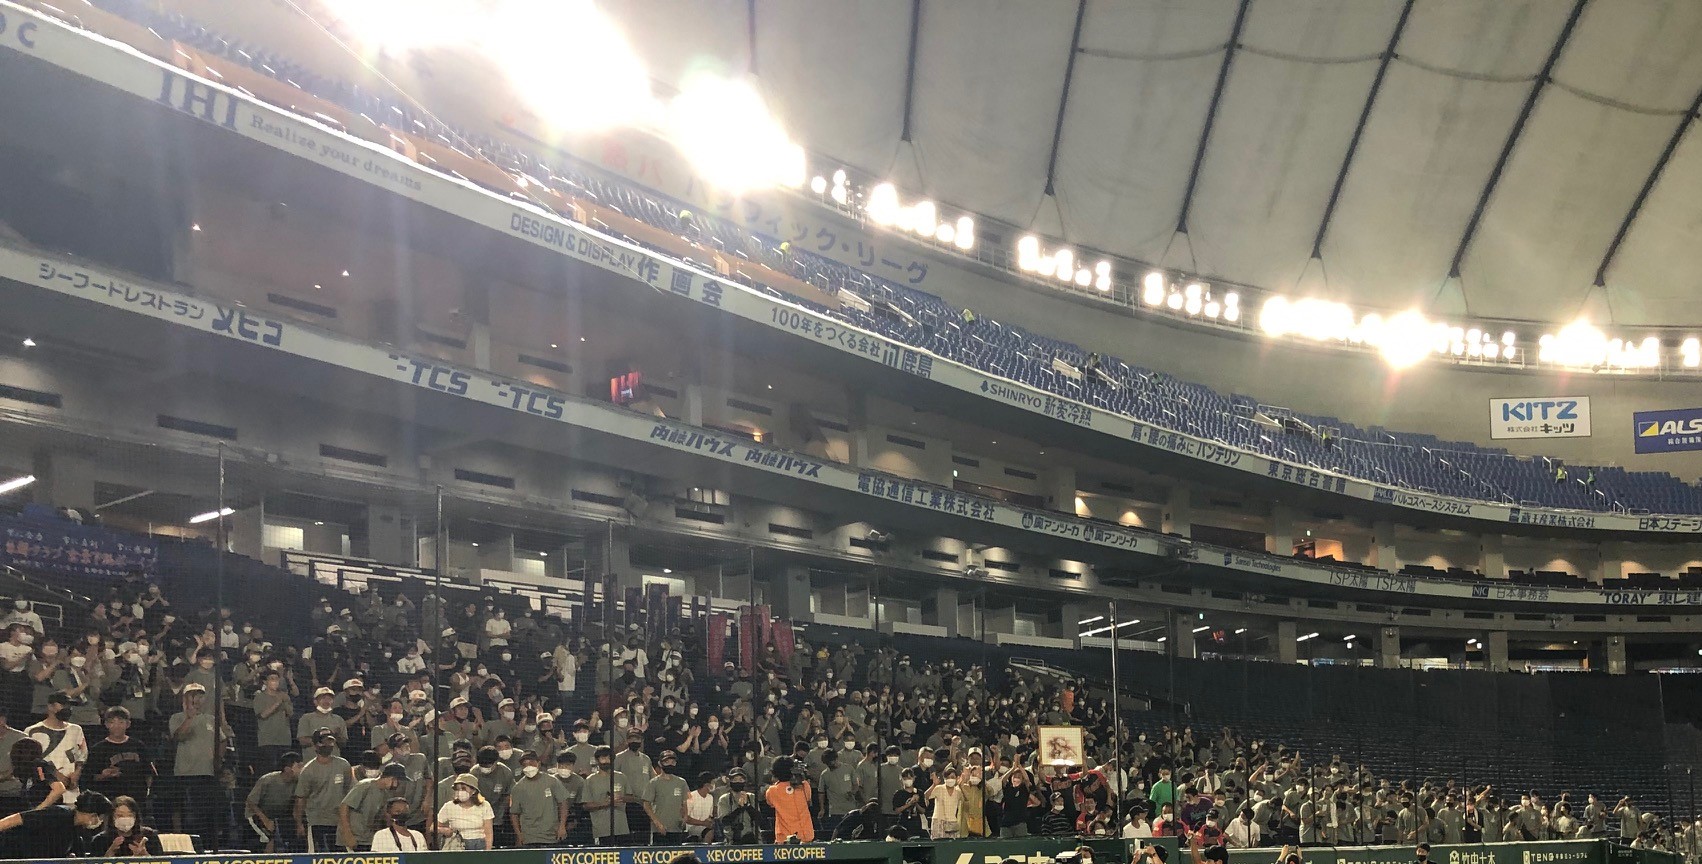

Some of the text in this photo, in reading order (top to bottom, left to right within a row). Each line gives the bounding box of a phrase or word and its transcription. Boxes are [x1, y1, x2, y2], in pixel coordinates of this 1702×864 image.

[154, 70, 240, 132] IHI
[250, 114, 422, 191] Realize your dreams
[510, 212, 636, 271] DESIGN & DISPLAY
[39, 262, 283, 346] シーフードレストラン メヒコ
[772, 306, 881, 358] 100年をつくる会社
[409, 359, 471, 395] TCS
[509, 386, 566, 419] TCS
[990, 383, 1042, 408] SHINRYO
[1043, 397, 1092, 427] 新菱冷熱
[1502, 401, 1578, 421] KITZ
[650, 424, 738, 457] 内藤ハウス
[1540, 423, 1575, 434] キッツ
[744, 448, 823, 478] 内藤ハウス
[857, 472, 995, 521] 電協通信工業株式会社
[1602, 592, 1649, 605] TORAY
